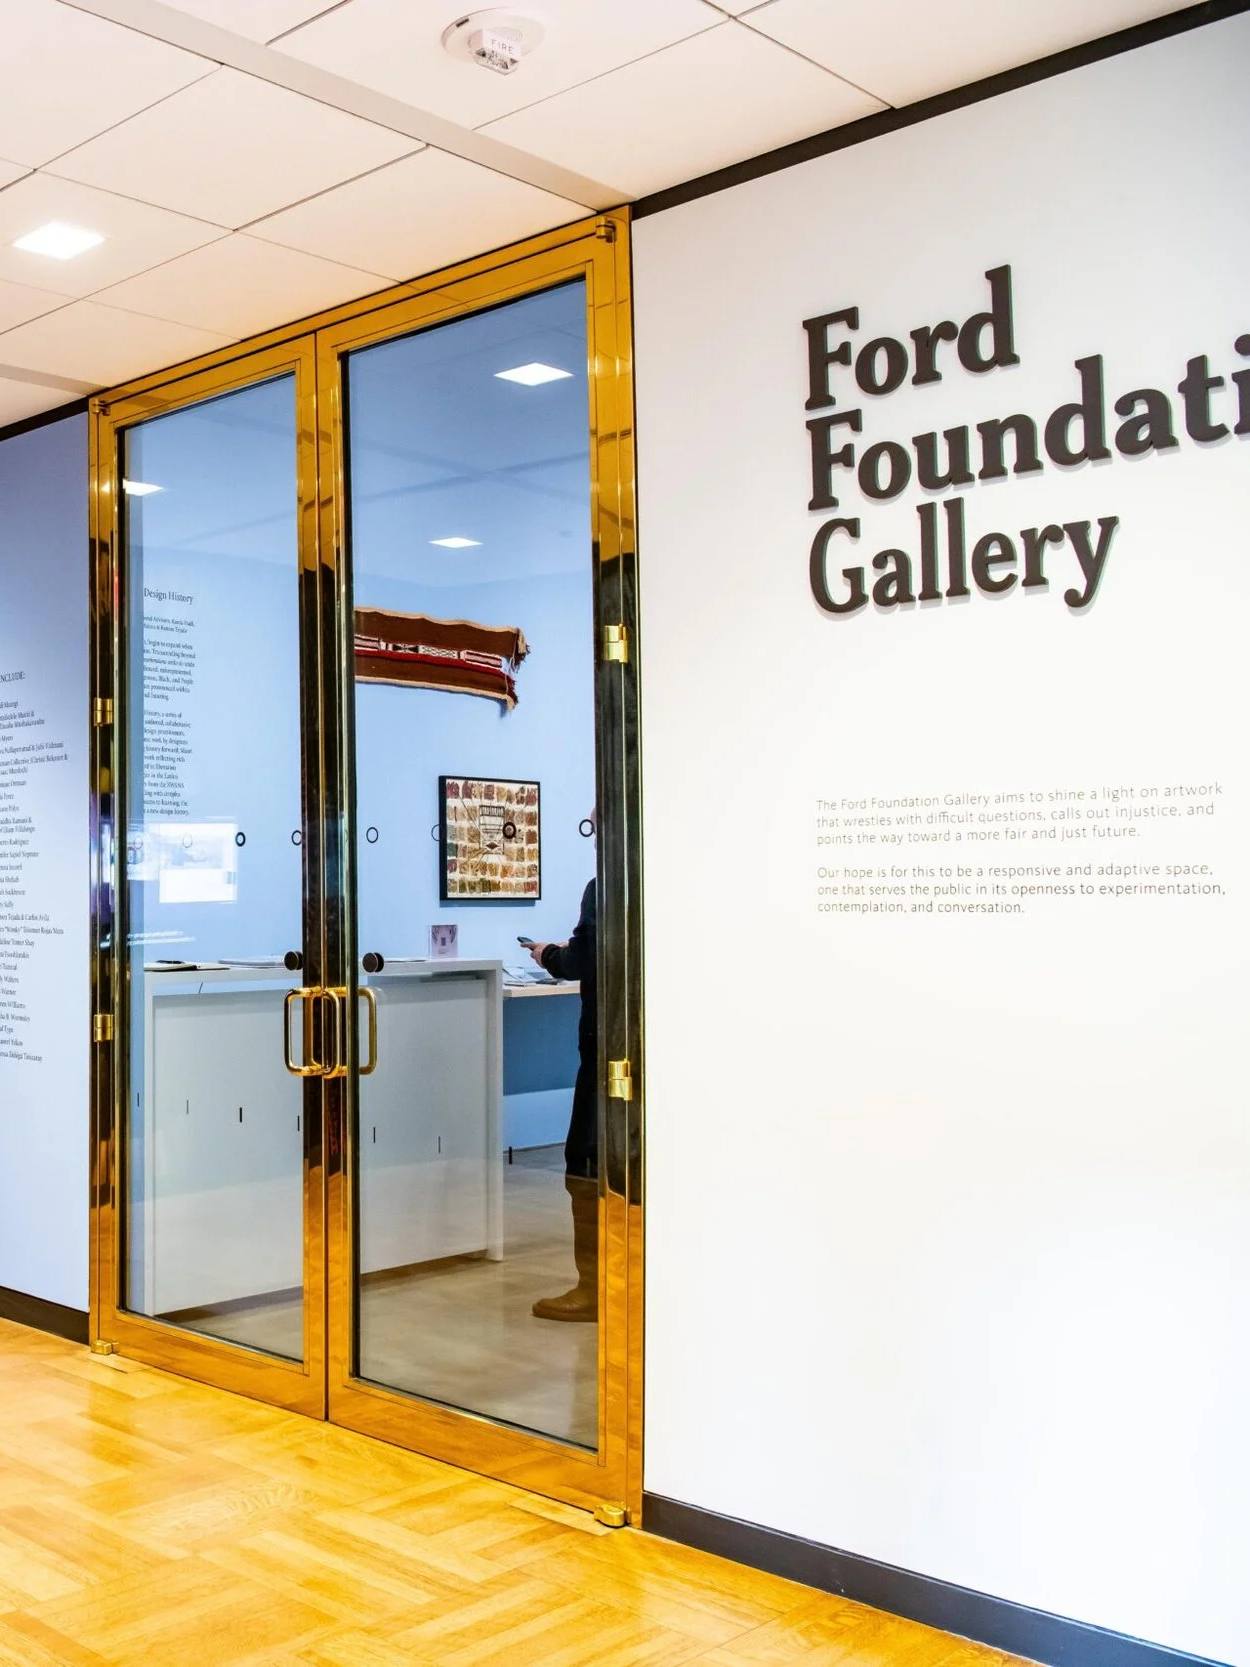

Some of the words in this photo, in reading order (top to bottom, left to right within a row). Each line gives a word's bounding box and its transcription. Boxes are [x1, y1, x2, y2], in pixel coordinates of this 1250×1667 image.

[802, 264, 1020, 411] Ford
[809, 497, 1119, 614] Gallery
[144, 588, 167, 602] Design
[168, 591, 194, 605] History
[816, 799, 837, 810] The
[841, 798, 867, 810] Ford
[871, 797, 940, 809] Foundation
[943, 793, 990, 807] Gallery
[994, 792, 1025, 804] aims
[1030, 792, 1044, 803] to
[1048, 789, 1085, 802] shine
[1090, 790, 1097, 801] a
[1103, 785, 1135, 803] light
[1140, 788, 1158, 798] on
[1164, 781, 1223, 797] artwork
[817, 816, 839, 828] that
[843, 815, 892, 827] wrestles
[896, 813, 922, 825] with
[926, 811, 974, 825] difficult
[977, 808, 1046, 824] questions,
[1050, 807, 1081, 820] calls
[1086, 808, 1111, 819] out
[1187, 801, 1214, 816] and
[817, 834, 853, 847] points
[857, 832, 876, 844] the
[880, 833, 903, 846] way
[907, 830, 950, 843] toward
[955, 831, 962, 841] a
[967, 830, 1000, 841] more
[1004, 827, 1027, 840] fair
[1031, 826, 1057, 839] and
[1060, 827, 1087, 842] just
[1091, 824, 1141, 838] future.
[817, 866, 839, 878] Our
[843, 866, 873, 880] hope
[877, 867, 887, 878] is
[891, 865, 908, 878] for
[912, 865, 935, 878] this
[939, 867, 952, 877] to
[956, 865, 972, 877] be
[976, 867, 983, 877] a
[988, 864, 1061, 879] responsive
[1066, 864, 1092, 876] and
[1097, 862, 1161, 878] adaptive
[1165, 864, 1213, 878] space,
[817, 885, 838, 896] one
[842, 884, 865, 895] that
[869, 886, 906, 896] serves
[910, 883, 930, 895] the
[934, 883, 971, 897] public
[975, 883, 988, 895] in
[992, 883, 1007, 895] its
[1011, 885, 1076, 898] openness
[1080, 883, 1095, 895] to
[1099, 883, 1227, 897] experimentation,
[817, 901, 907, 914] contemplation,
[910, 900, 934, 912] and
[937, 901, 1026, 913] conversation.
